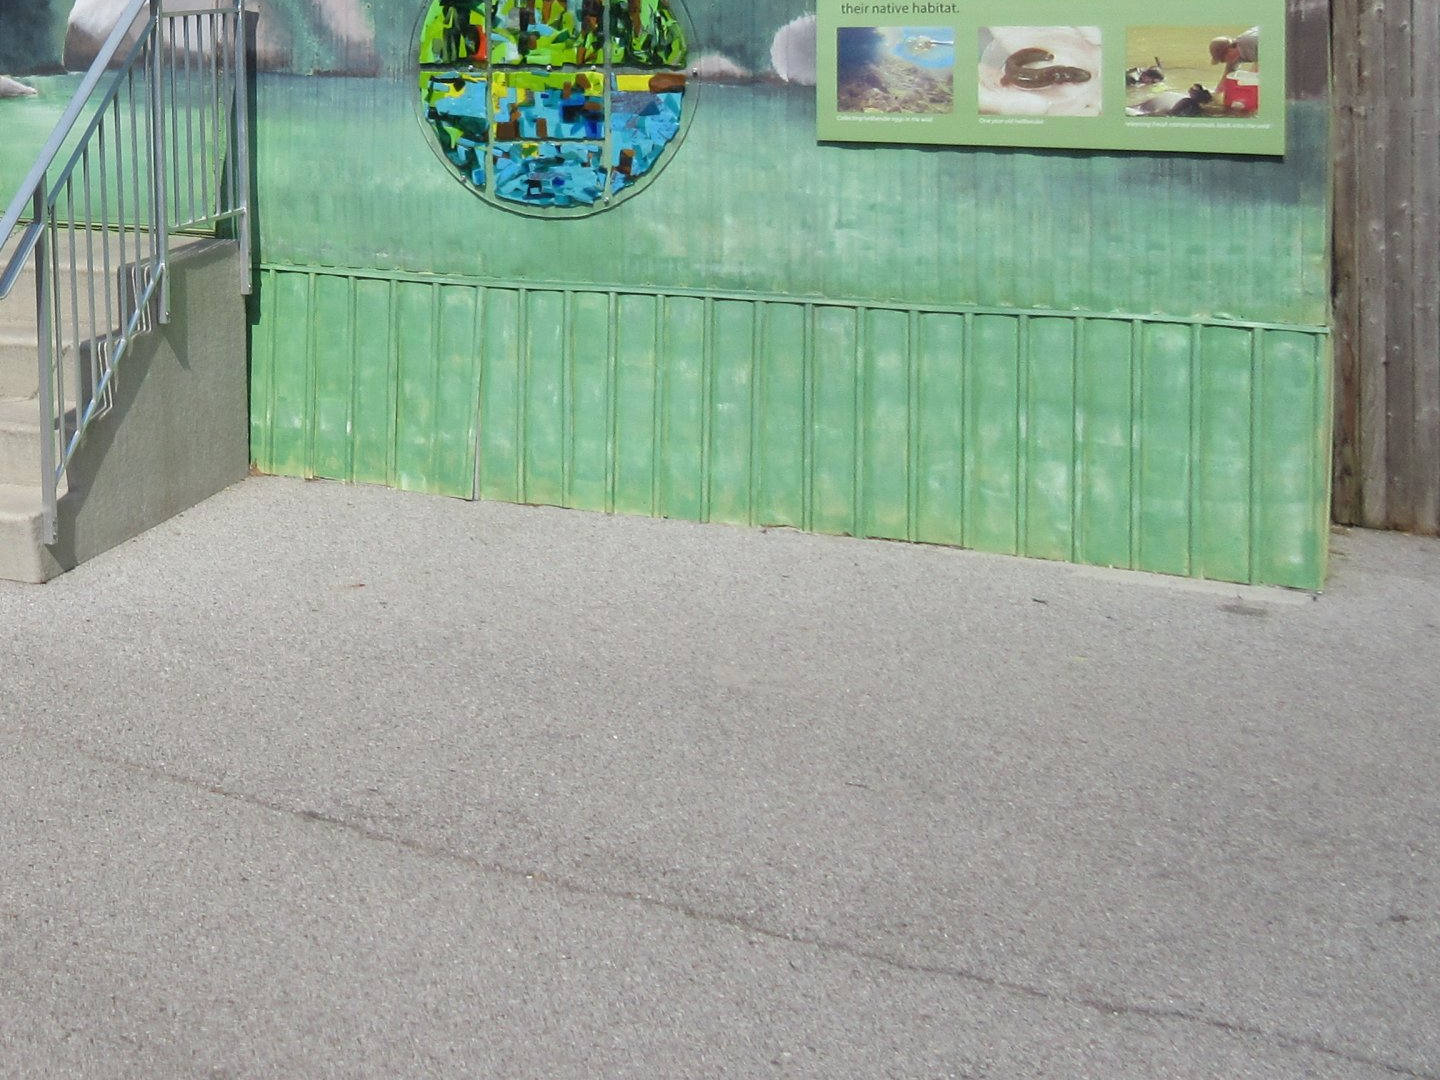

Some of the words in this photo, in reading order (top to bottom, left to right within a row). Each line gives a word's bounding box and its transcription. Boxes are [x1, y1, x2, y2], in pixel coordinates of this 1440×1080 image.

[841, 2, 869, 14] their
[872, 2, 909, 14] native
[912, 2, 960, 14] habitat.
